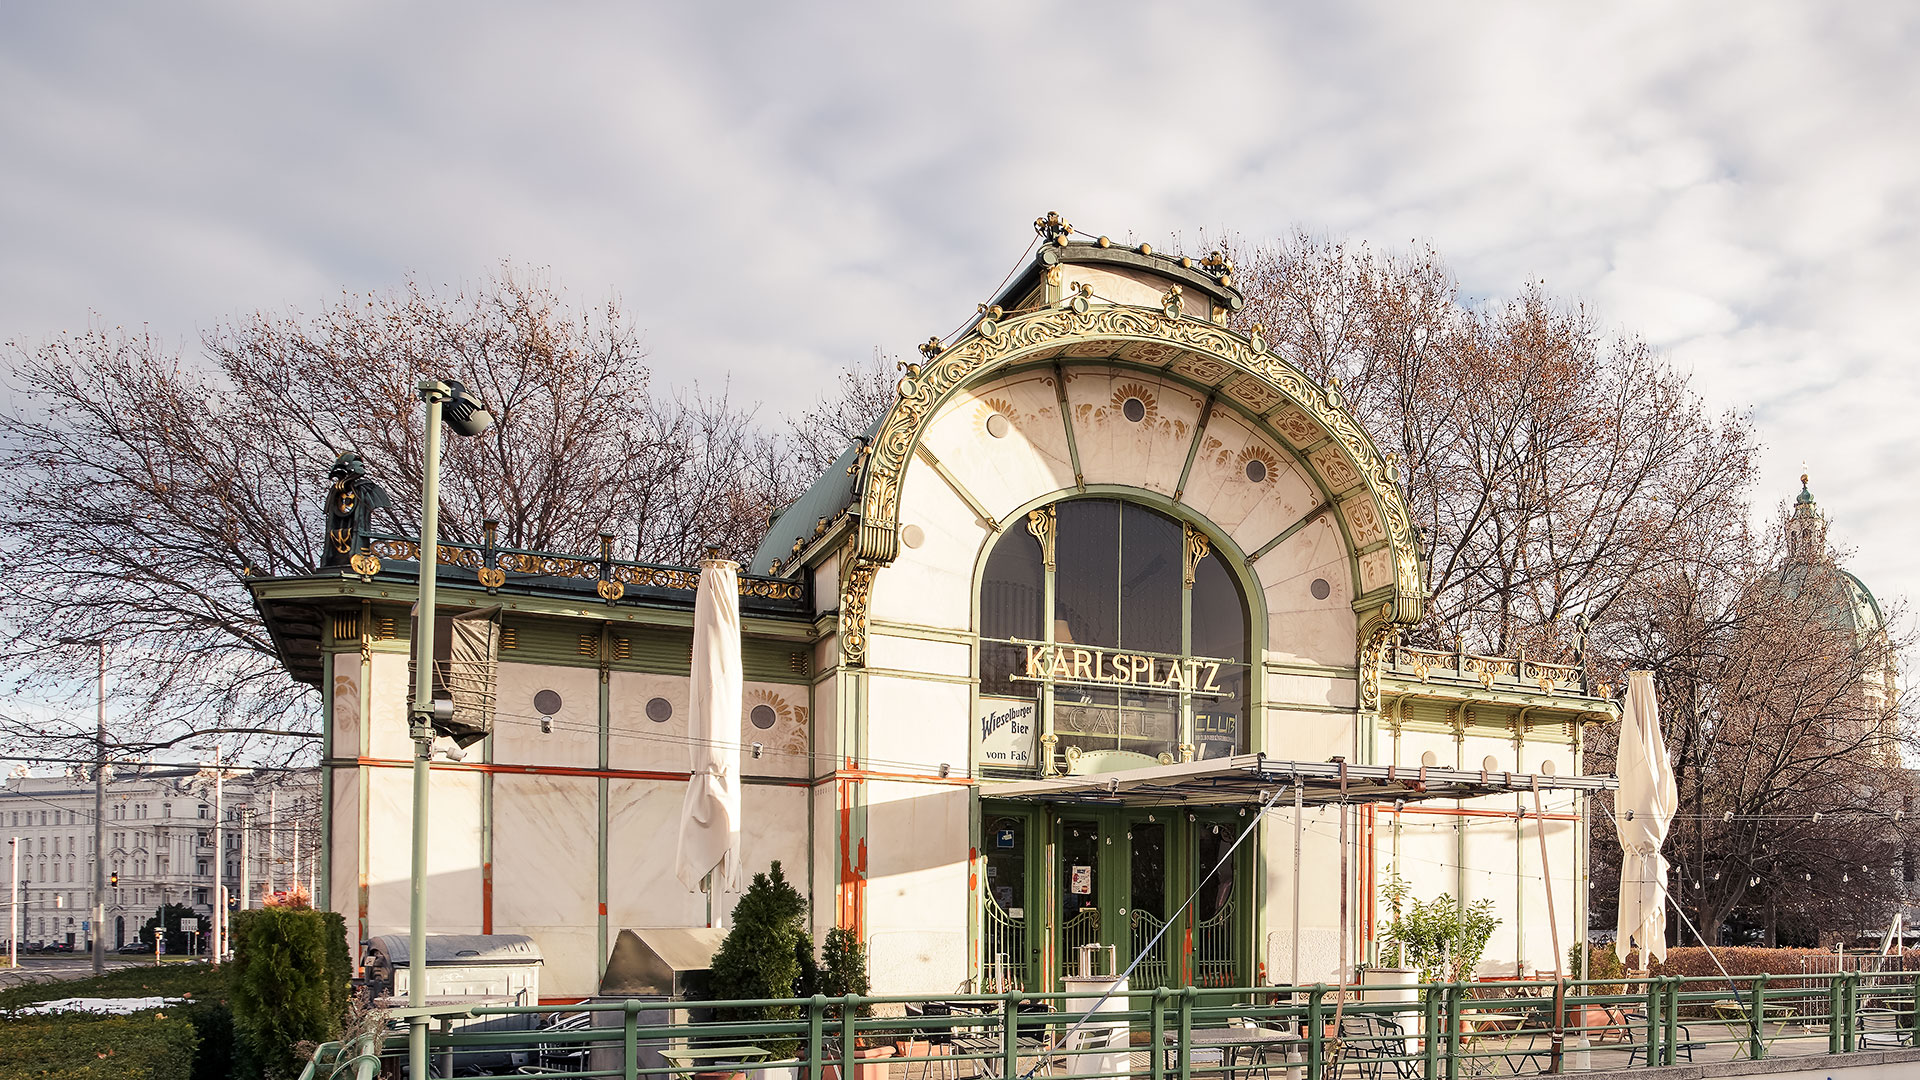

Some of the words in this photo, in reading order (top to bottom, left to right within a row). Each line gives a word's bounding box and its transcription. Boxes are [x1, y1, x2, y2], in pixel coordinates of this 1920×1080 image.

[1025, 645, 1221, 691] KARLSPLATZ
[981, 706, 1033, 744] Wieselburger
[1011, 720, 1029, 735] Bier
[1195, 714, 1236, 734] CLUB
[986, 751, 1006, 760] vom
[1010, 750, 1028, 761] Faß
